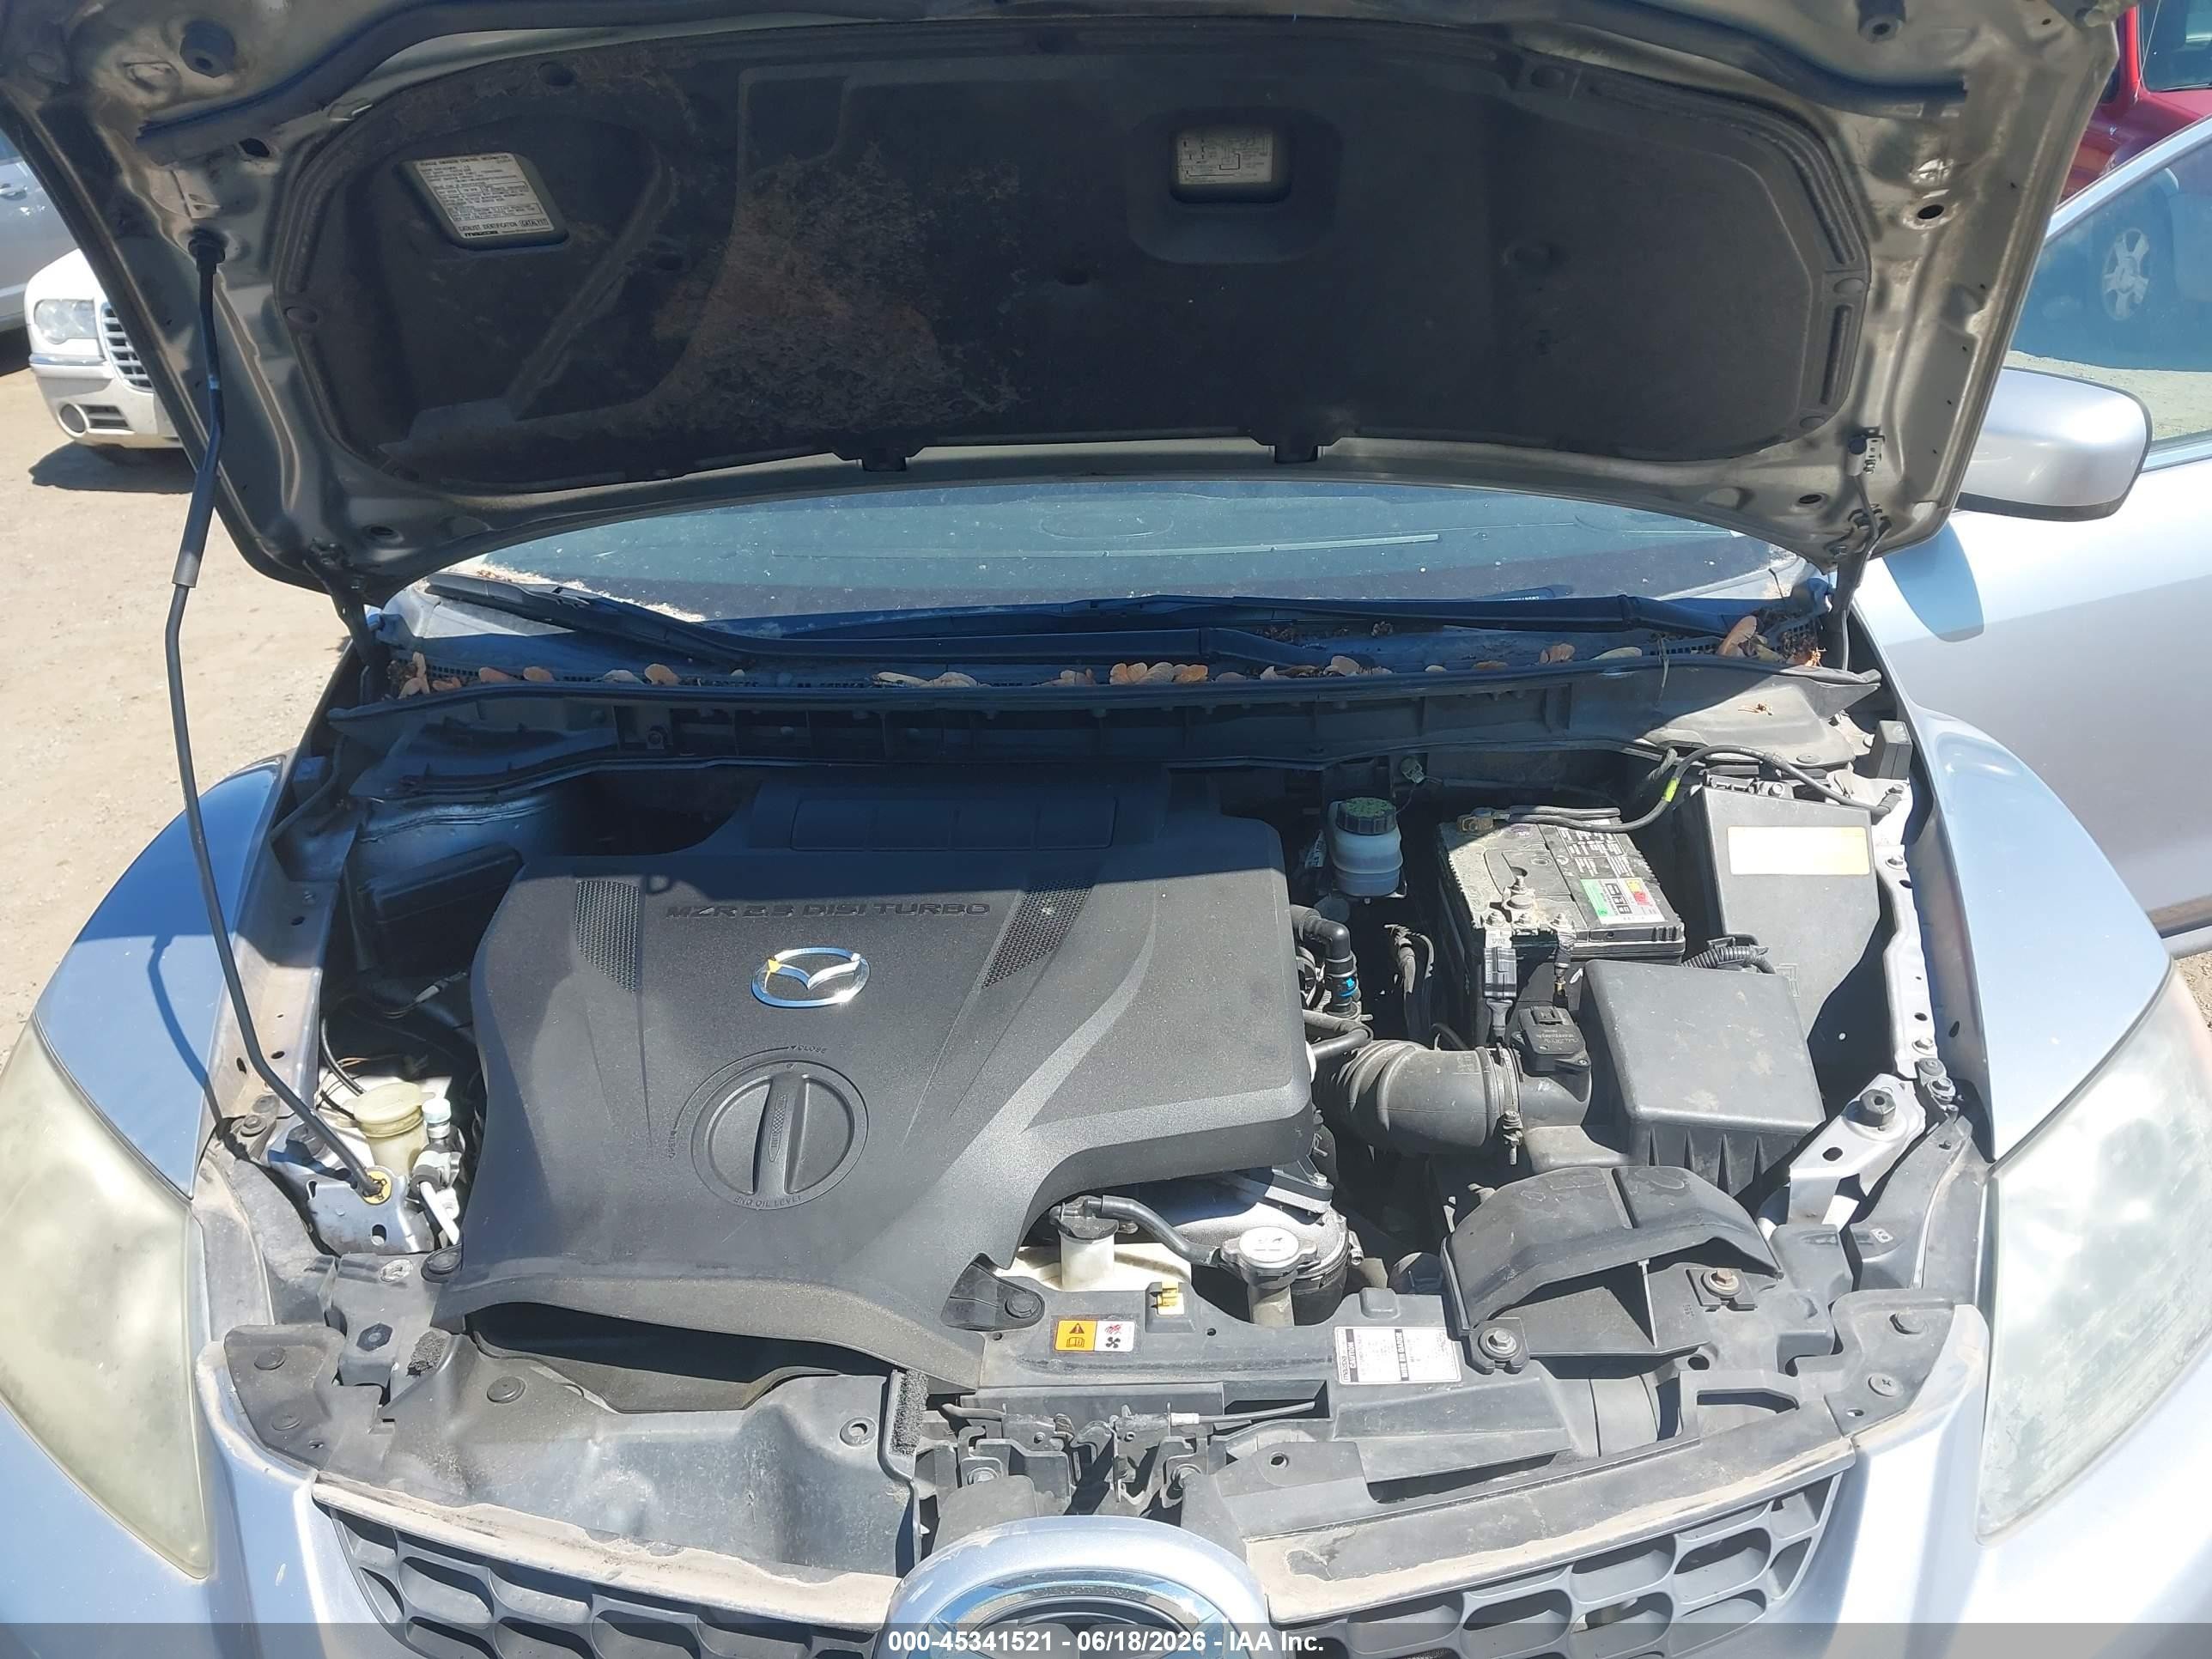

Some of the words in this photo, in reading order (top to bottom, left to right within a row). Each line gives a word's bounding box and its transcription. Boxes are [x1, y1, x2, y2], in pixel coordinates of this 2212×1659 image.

[665, 905, 737, 919] MZR
[802, 903, 866, 918] DISI
[873, 902, 991, 916] TURBO
[1347, 1341, 1356, 1369] CAUTION
